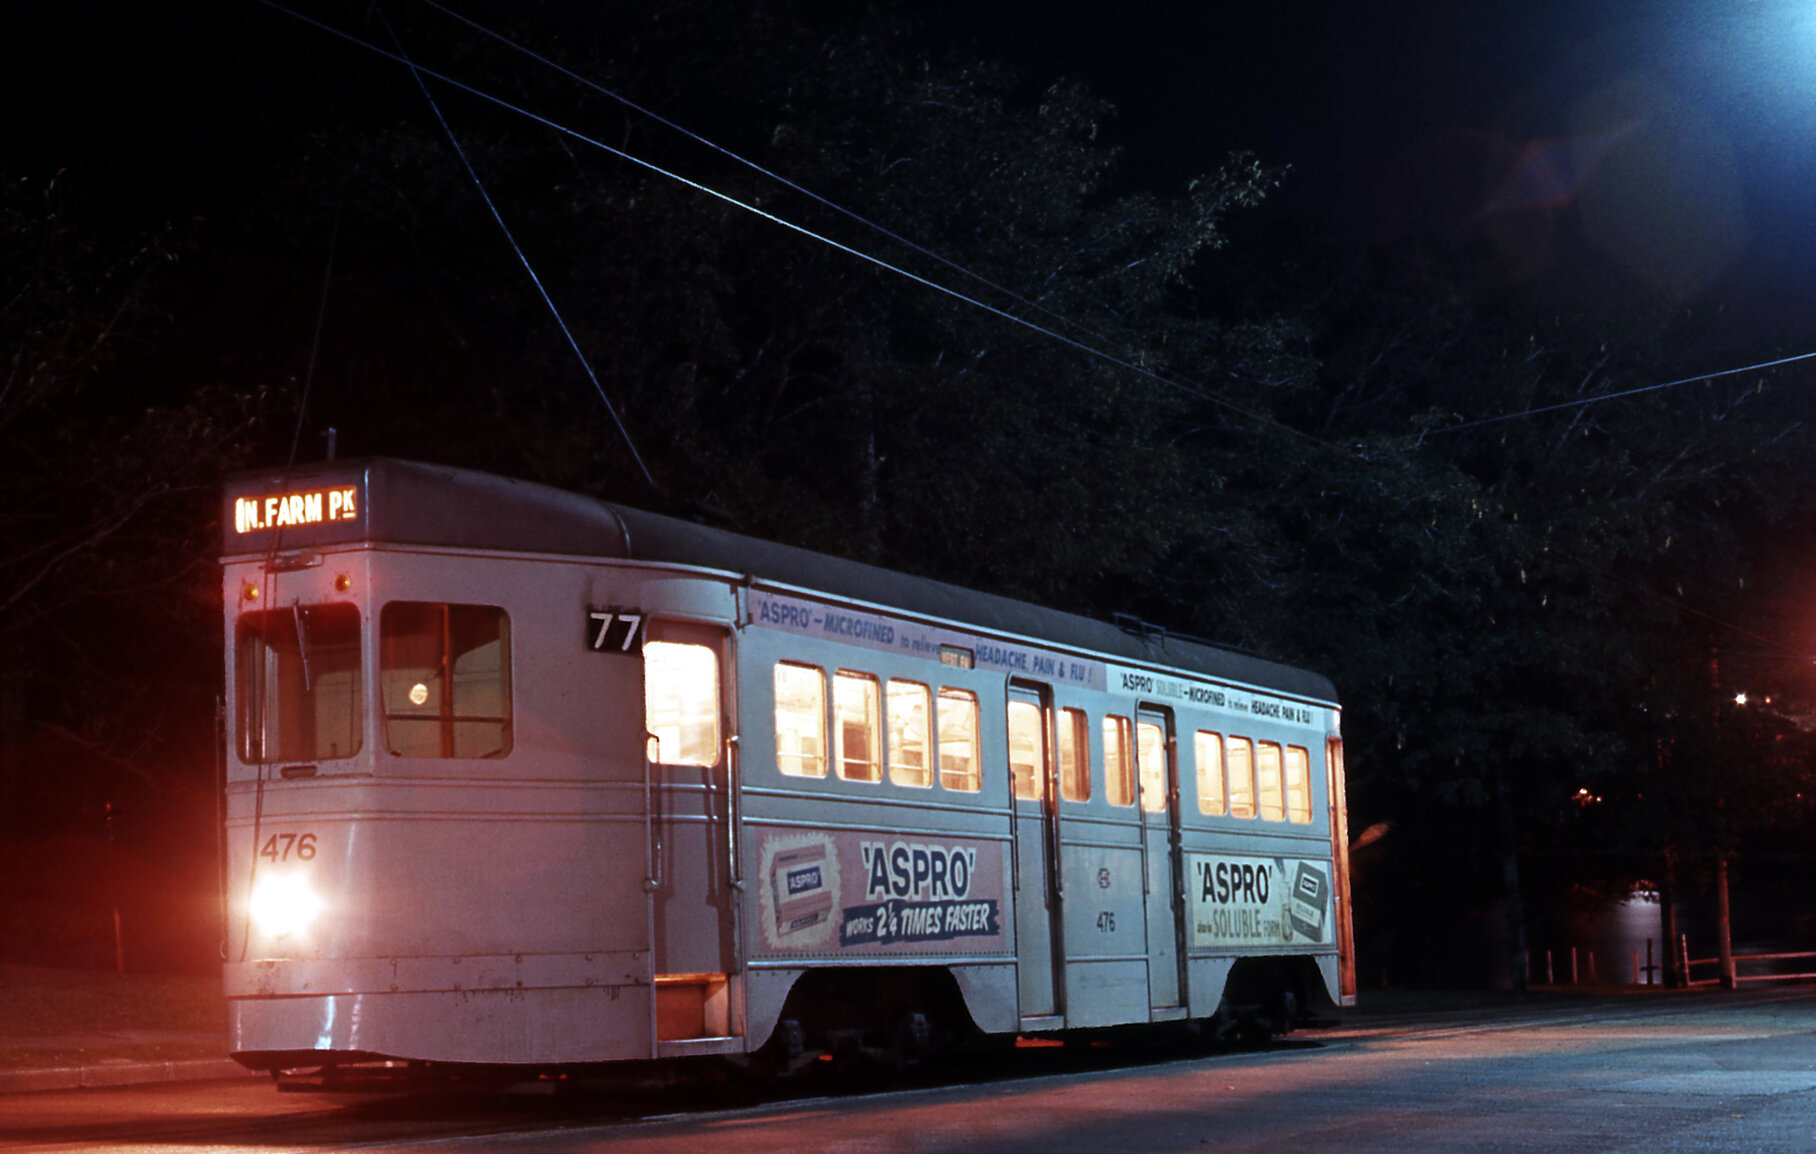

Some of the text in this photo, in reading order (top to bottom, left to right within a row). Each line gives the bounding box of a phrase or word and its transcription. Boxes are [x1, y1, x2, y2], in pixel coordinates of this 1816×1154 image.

[590, 612, 641, 651] 77
[823, 612, 894, 645] MICROFINED
[1033, 655, 1056, 676] PAIN
[1058, 661, 1065, 679] &
[260, 833, 317, 863] 476
[862, 843, 975, 899] 'ASPRO'
[1197, 862, 1273, 905] 'ASPRO'
[846, 916, 874, 938] WORKS
[901, 905, 943, 936] TIMES
[945, 903, 990, 932] FASTER
[1096, 911, 1116, 933] 476
[1213, 909, 1262, 938] SOLUBLE
